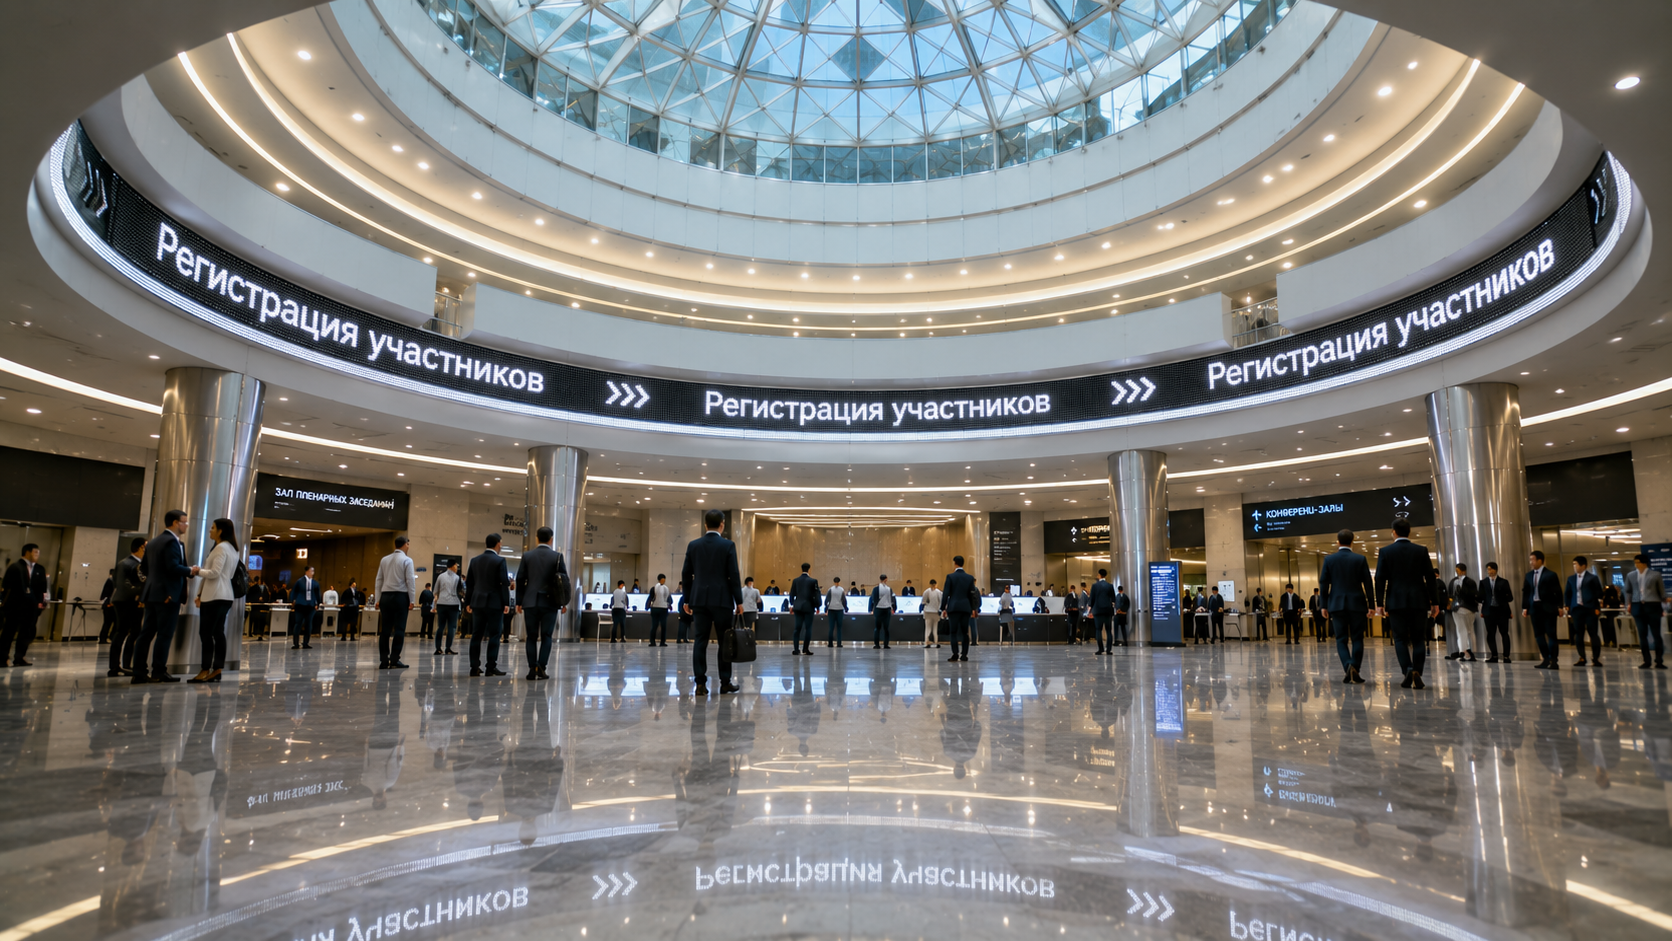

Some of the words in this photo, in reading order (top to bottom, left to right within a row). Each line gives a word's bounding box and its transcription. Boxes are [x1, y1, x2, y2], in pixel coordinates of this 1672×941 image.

[156, 222, 359, 348] Регистрация
[368, 330, 544, 393] участников
[1208, 322, 1388, 389] Регистрация
[1395, 239, 1555, 348] участников
[705, 391, 883, 426] Регистрация
[892, 394, 1051, 426] участников
